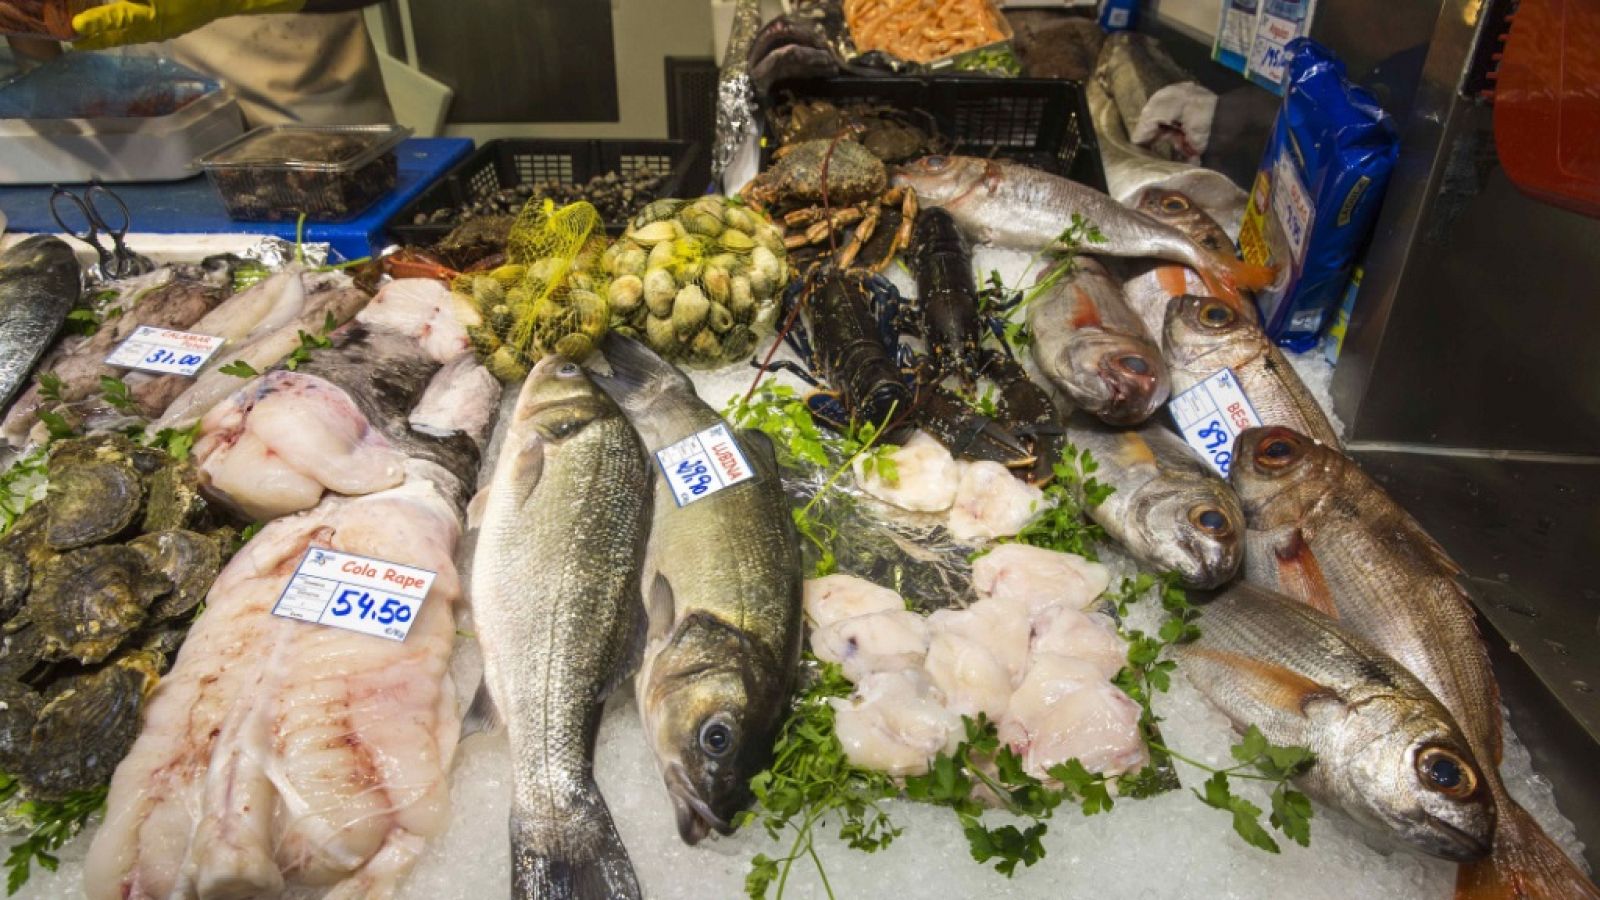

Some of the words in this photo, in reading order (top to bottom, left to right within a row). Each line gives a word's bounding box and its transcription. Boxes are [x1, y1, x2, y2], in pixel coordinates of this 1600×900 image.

[711, 441, 744, 481] LUBINA
[341, 560, 377, 578] Cola
[383, 568, 426, 589] Rape
